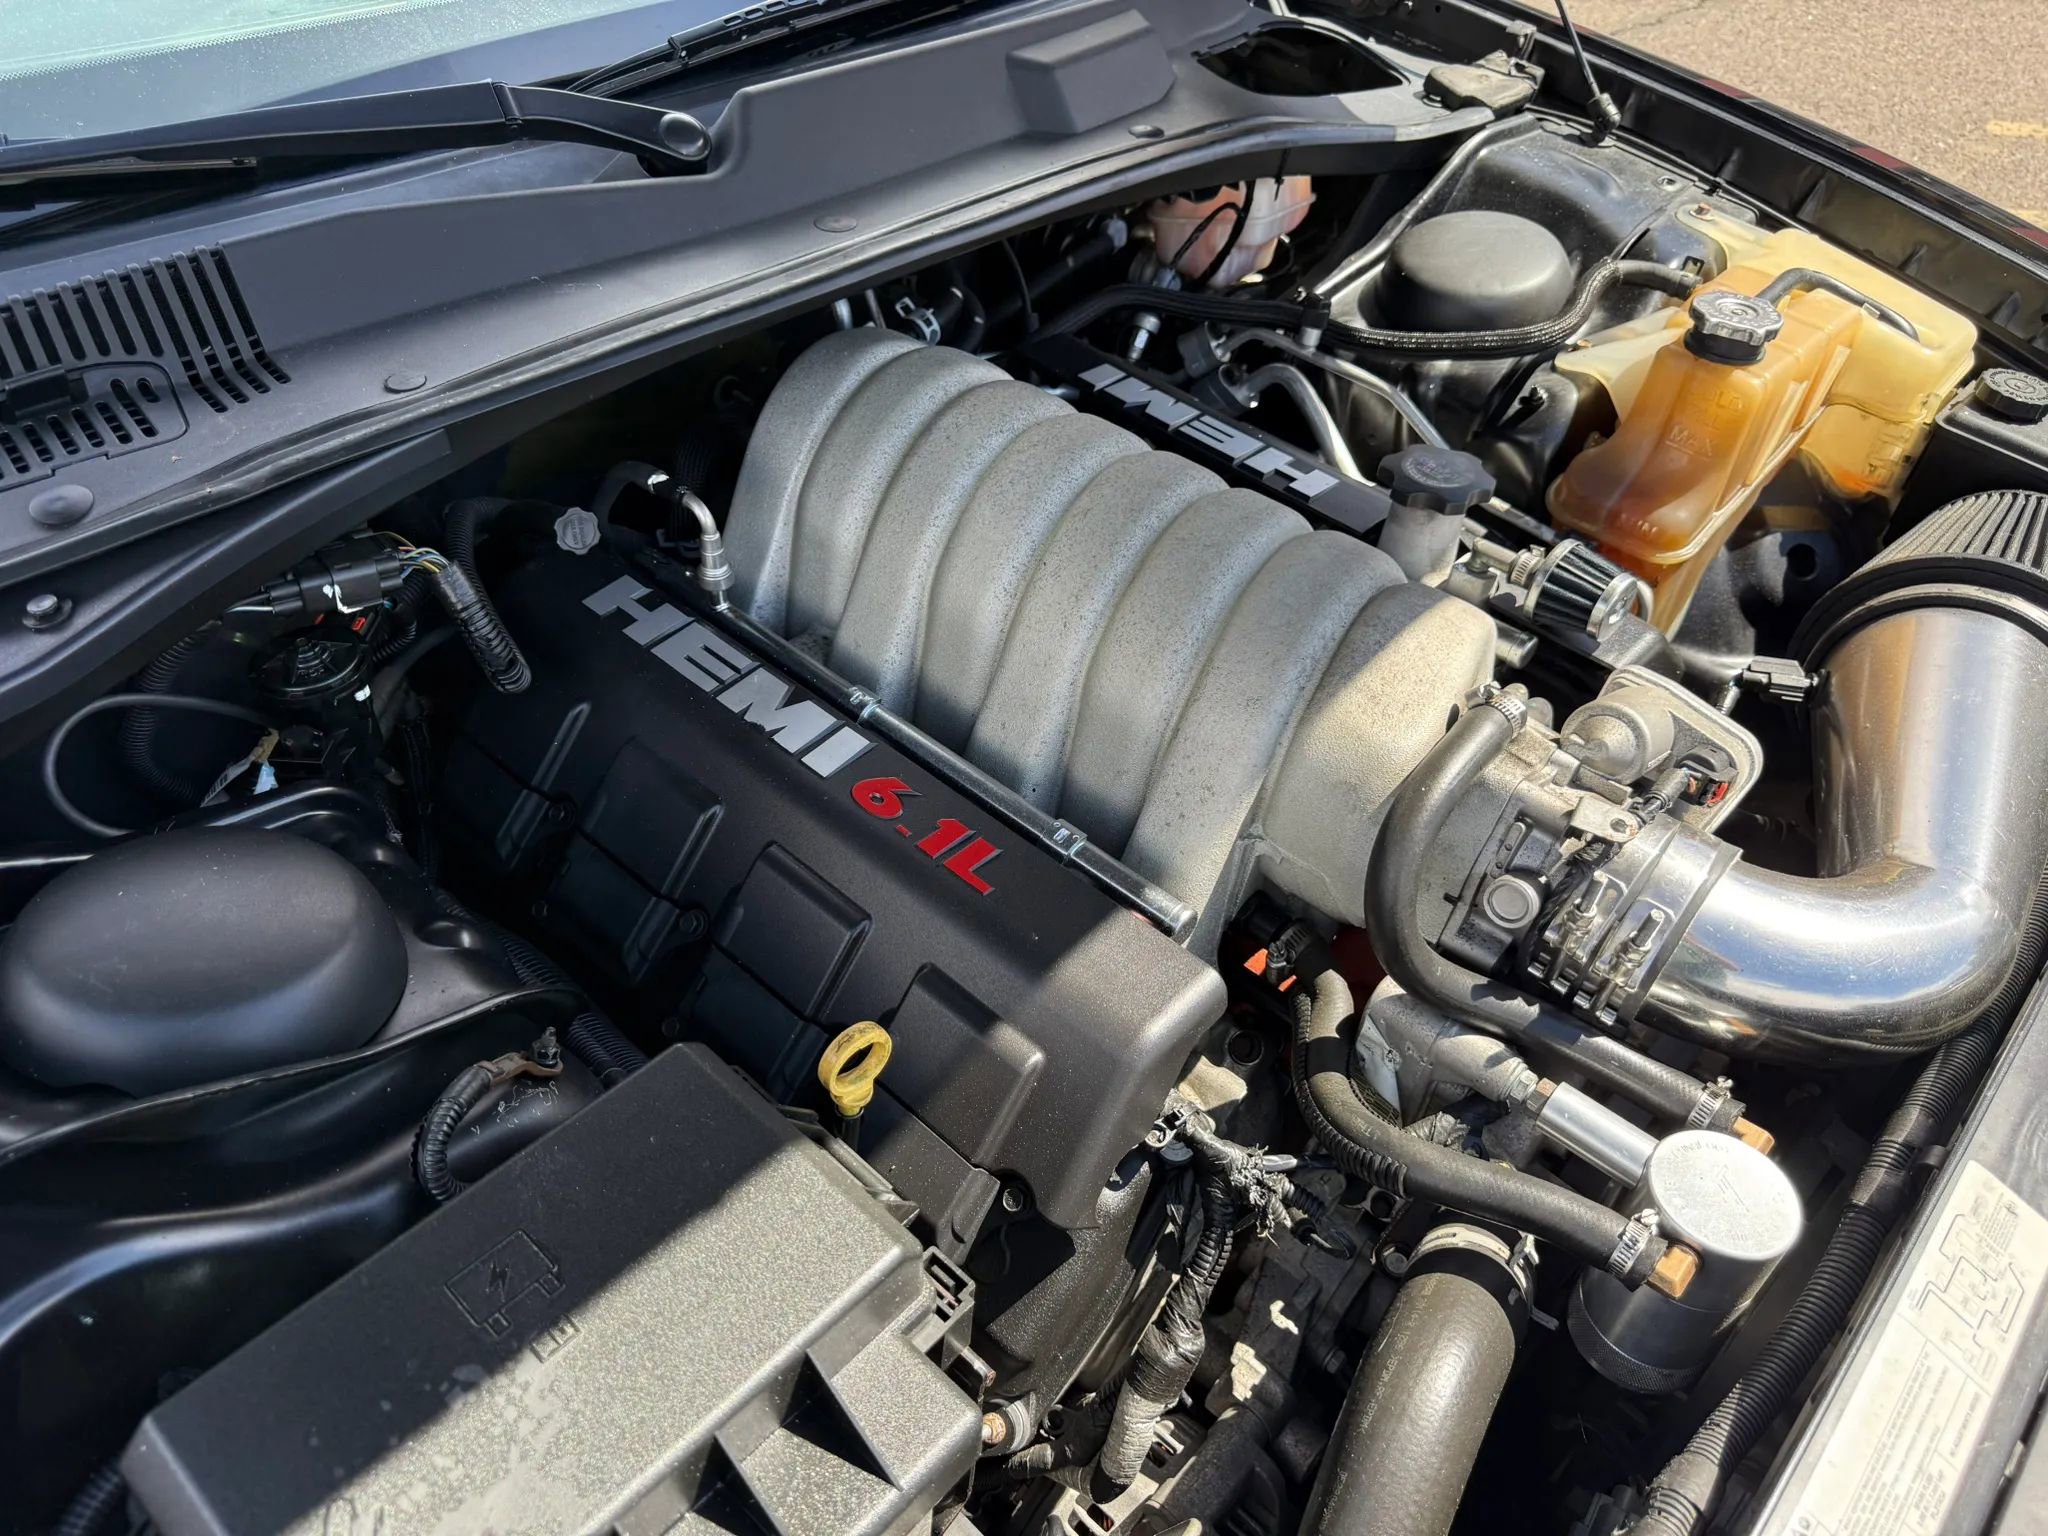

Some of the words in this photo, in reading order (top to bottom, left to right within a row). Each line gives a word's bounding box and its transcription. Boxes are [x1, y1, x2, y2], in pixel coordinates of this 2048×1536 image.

[1077, 363, 1340, 499] HEMI
[582, 574, 876, 778] HEMI
[851, 776, 1003, 895] 6.1L
